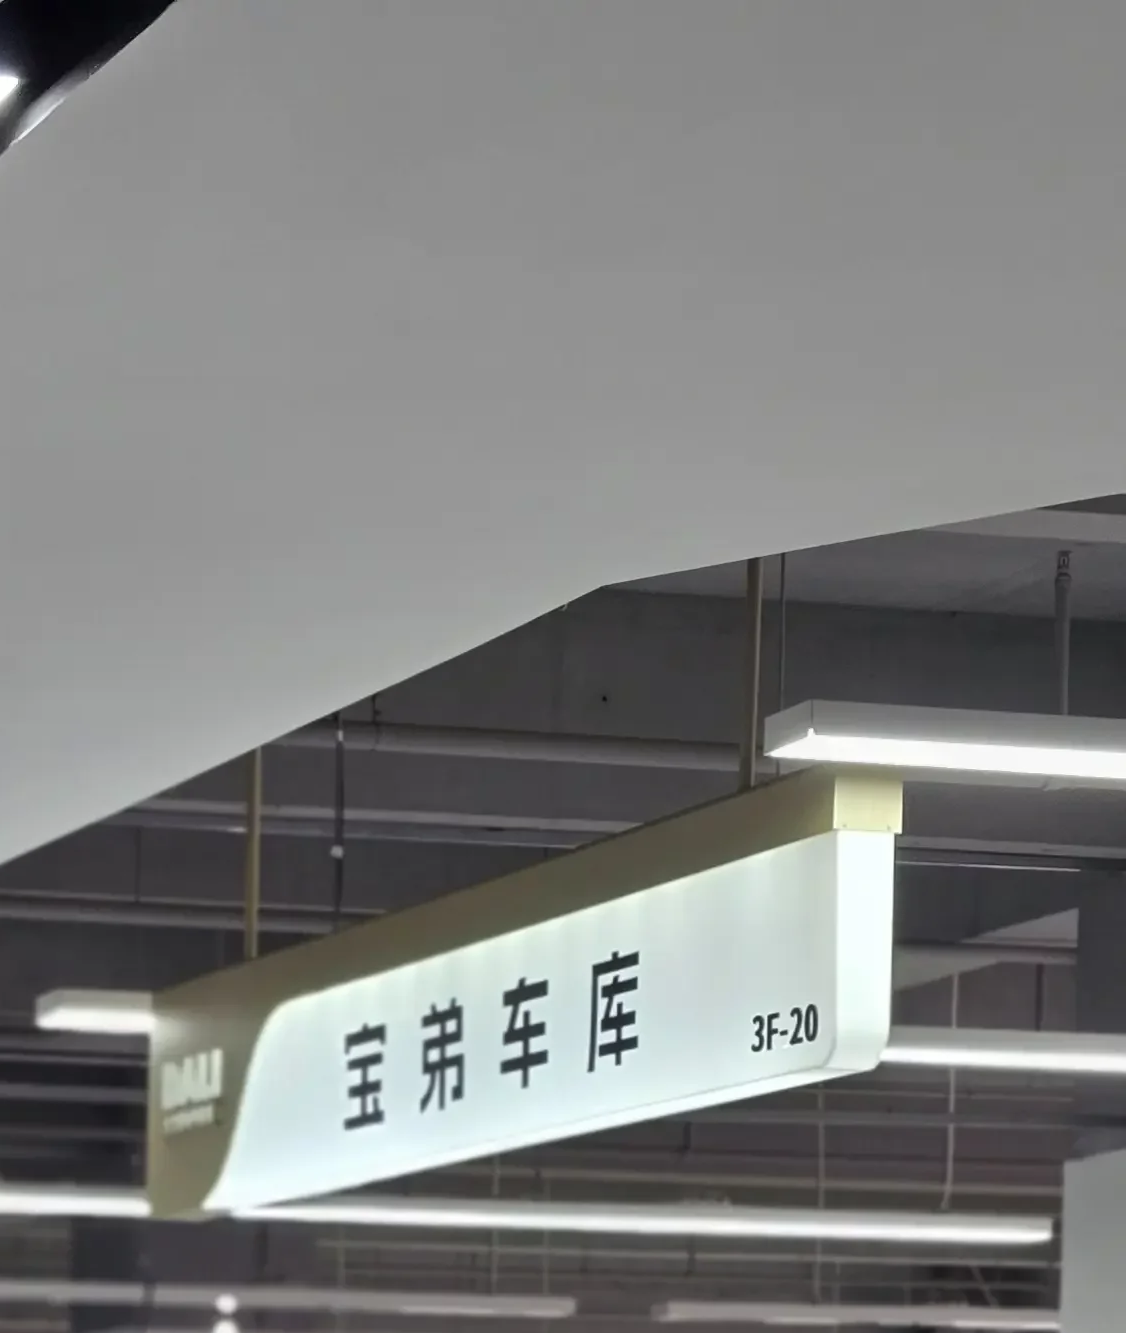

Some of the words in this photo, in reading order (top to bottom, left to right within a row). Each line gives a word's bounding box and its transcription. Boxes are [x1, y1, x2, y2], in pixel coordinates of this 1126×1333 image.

[343, 950, 640, 1131] 宝弟车库
[750, 1003, 819, 1053] 3F-20
